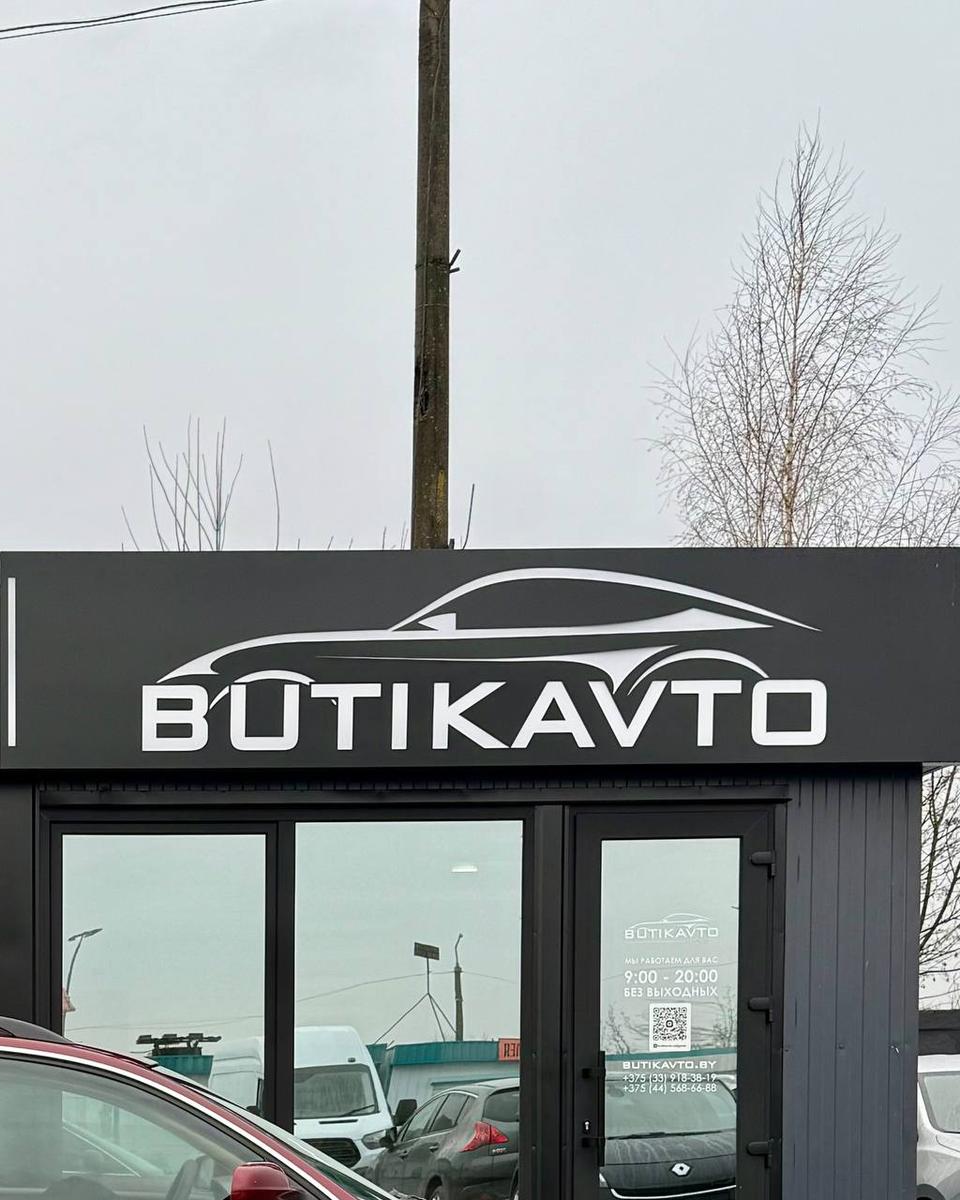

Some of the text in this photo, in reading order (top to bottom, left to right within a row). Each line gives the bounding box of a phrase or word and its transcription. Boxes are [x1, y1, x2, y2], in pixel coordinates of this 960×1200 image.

[142, 679, 828, 753] BUTIKAVTO
[624, 927, 719, 940] BUTIKAVTO
[624, 957, 639, 965] МЫ
[640, 957, 684, 965] РАБОТАЕМ
[702, 956, 719, 964] ВАС
[624, 970, 657, 984] 9:00
[675, 969, 718, 983] 20:00
[624, 986, 719, 998] БЕЗ ВЫХОДНЫХ
[622, 1060, 717, 1069] BUTIKAVTO.BY
[622, 1072, 717, 1084] +375 (33) 918-38-19
[622, 1083, 717, 1095] +375 (44) 568-66-88
